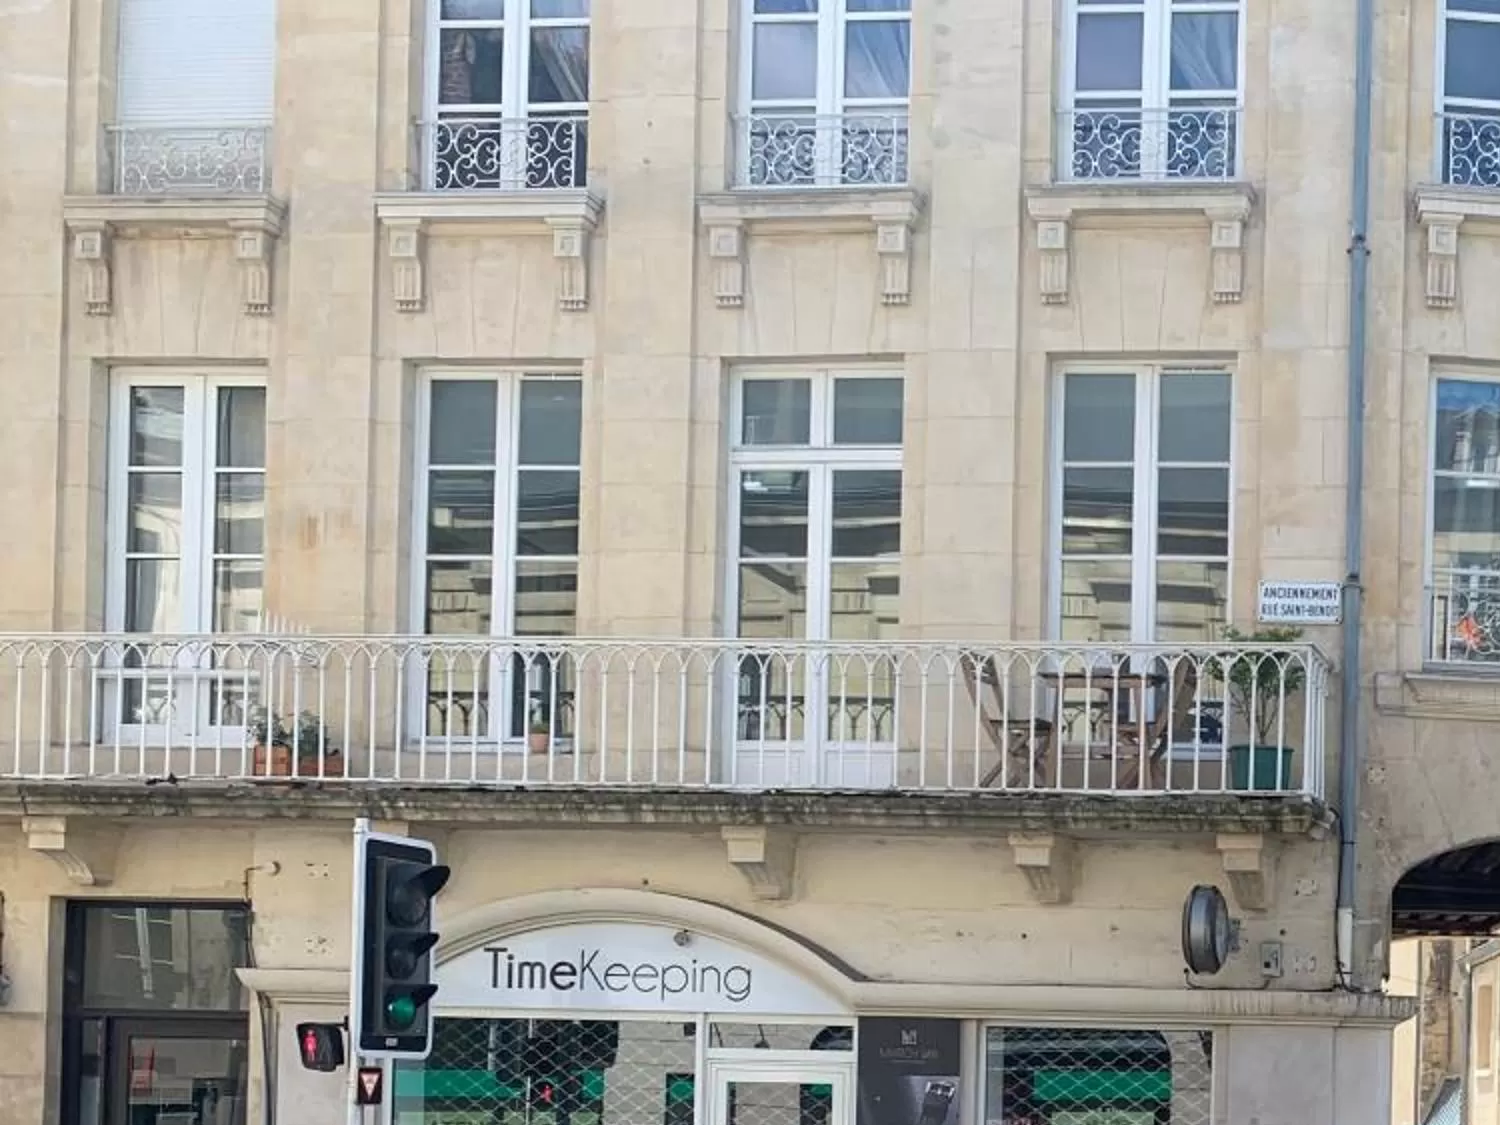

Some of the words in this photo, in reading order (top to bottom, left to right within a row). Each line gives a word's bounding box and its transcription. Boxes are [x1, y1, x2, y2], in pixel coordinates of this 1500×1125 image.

[1263, 587, 1337, 601] ANCIENNEMENT
[1261, 602, 1279, 617] RUE
[483, 946, 753, 1002] TimeKeeping
